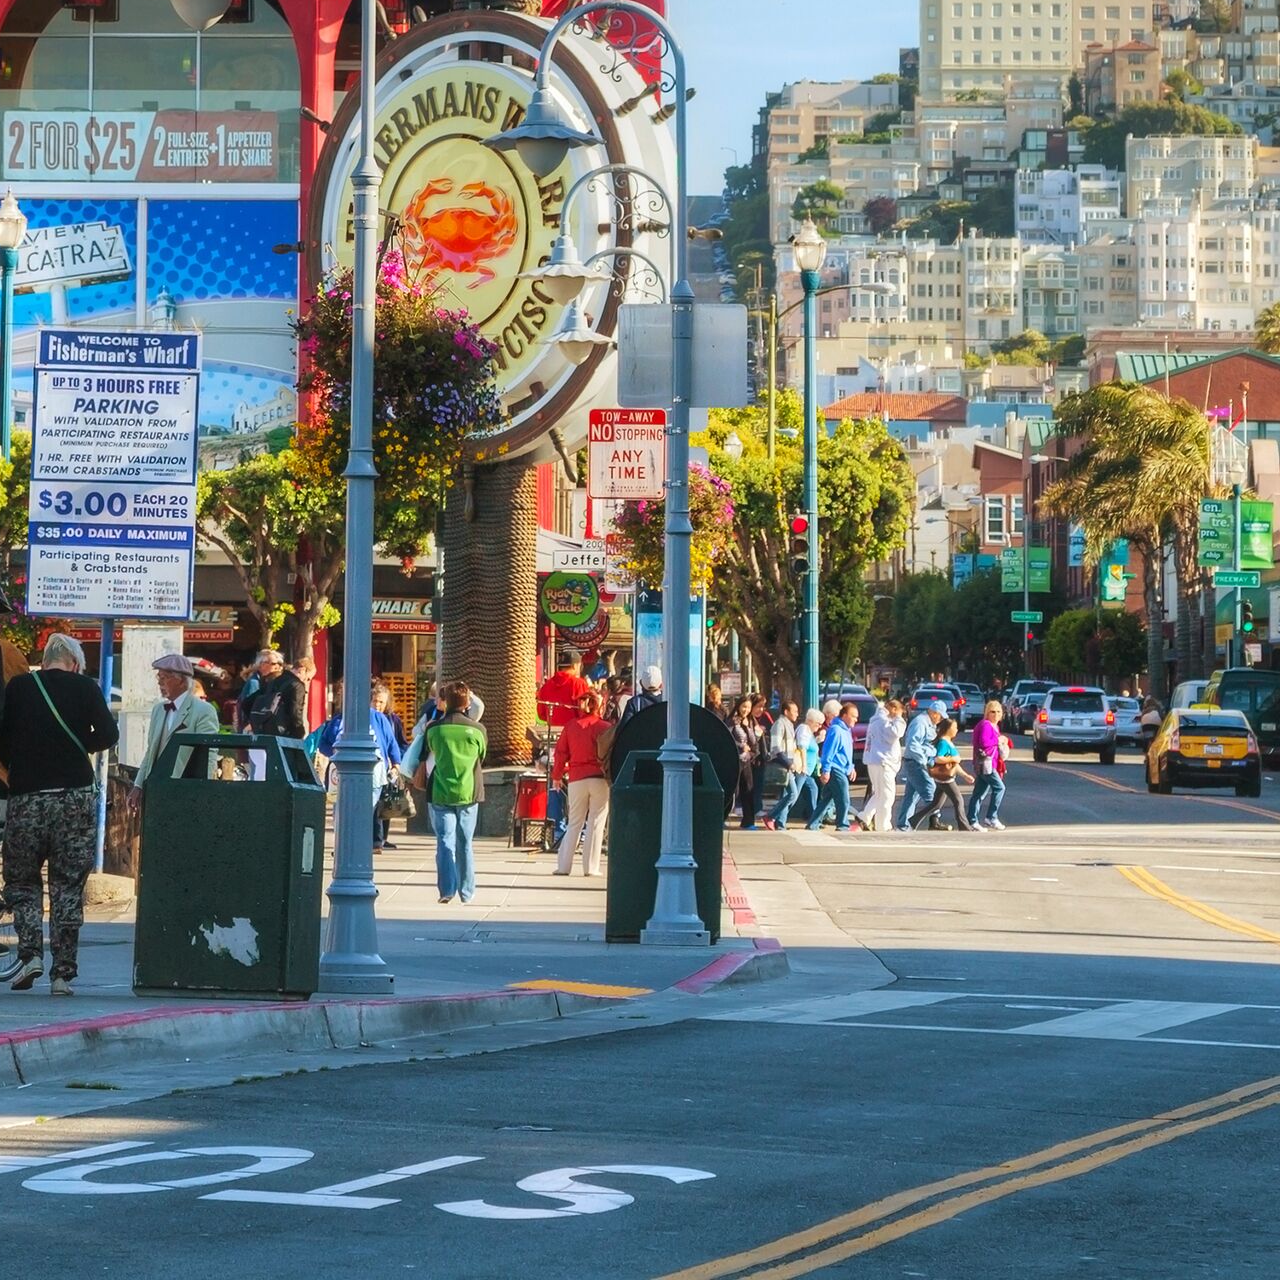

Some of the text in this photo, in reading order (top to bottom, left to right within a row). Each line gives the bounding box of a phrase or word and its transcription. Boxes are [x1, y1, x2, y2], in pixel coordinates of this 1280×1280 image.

[9, 116, 136, 175] 2 FOR $25
[167, 131, 209, 148] FULL-SIZE
[227, 131, 272, 148] APPETIZER
[153, 126, 166, 167] 2
[167, 149, 209, 167] ENTREES
[227, 149, 272, 167] TO SHARE
[77, 335, 161, 346] WELCOME TO
[49, 335, 189, 365] Fisherman's Wharf
[52, 377, 180, 395] UP TO 3 HOURS FREE
[73, 398, 159, 415] PARKING
[54, 416, 177, 428] WITH VALIDATION FROM
[601, 412, 654, 422] TOW-AWAY
[41, 429, 189, 441] PARTICIPATING RESTAURANTS
[591, 424, 662, 440] NO STOPPING
[48, 453, 64, 462] HR.
[70, 454, 92, 463] FREE
[97, 455, 122, 464] WITH
[128, 455, 187, 465] VALIDATION
[611, 450, 643, 462] ANY
[39, 465, 69, 474] FROM
[73, 465, 141, 476] CRABSTANDS
[608, 467, 645, 479] TIME
[39, 489, 127, 517] $3.00
[133, 494, 188, 506] EACH 20
[133, 508, 188, 519] MINUTES
[1204, 503, 1221, 512] en.
[1212, 518, 1230, 527] tre.
[37, 526, 188, 541] $35.00 DAILY MAXIMUM
[1201, 529, 1218, 538] pre.
[40, 550, 180, 564] Participating Restaurants
[561, 555, 606, 565] Jeffer
[70, 563, 148, 574] & Crabstands
